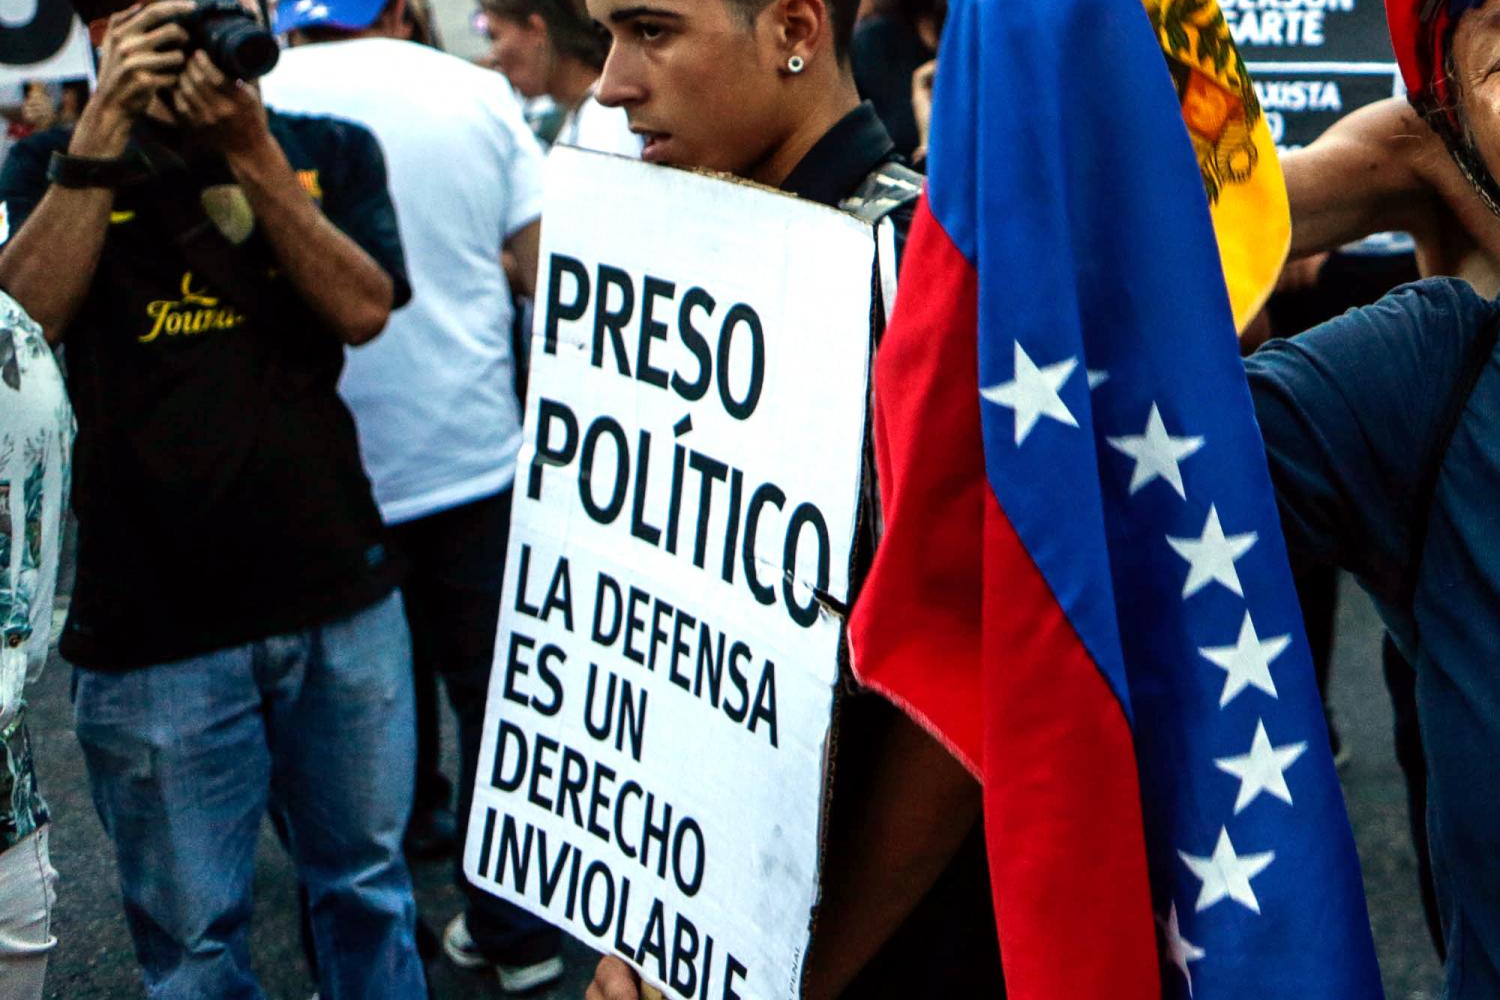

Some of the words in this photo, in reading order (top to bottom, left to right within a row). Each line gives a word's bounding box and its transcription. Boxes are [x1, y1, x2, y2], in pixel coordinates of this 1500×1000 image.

[544, 253, 765, 421] PRESO
[527, 412, 831, 629] POLÍTICO
[503, 631, 567, 717] ES
[584, 663, 648, 762] UN
[515, 544, 574, 632] LA
[591, 572, 778, 749] DEFENSA
[491, 719, 705, 897] DERECHO
